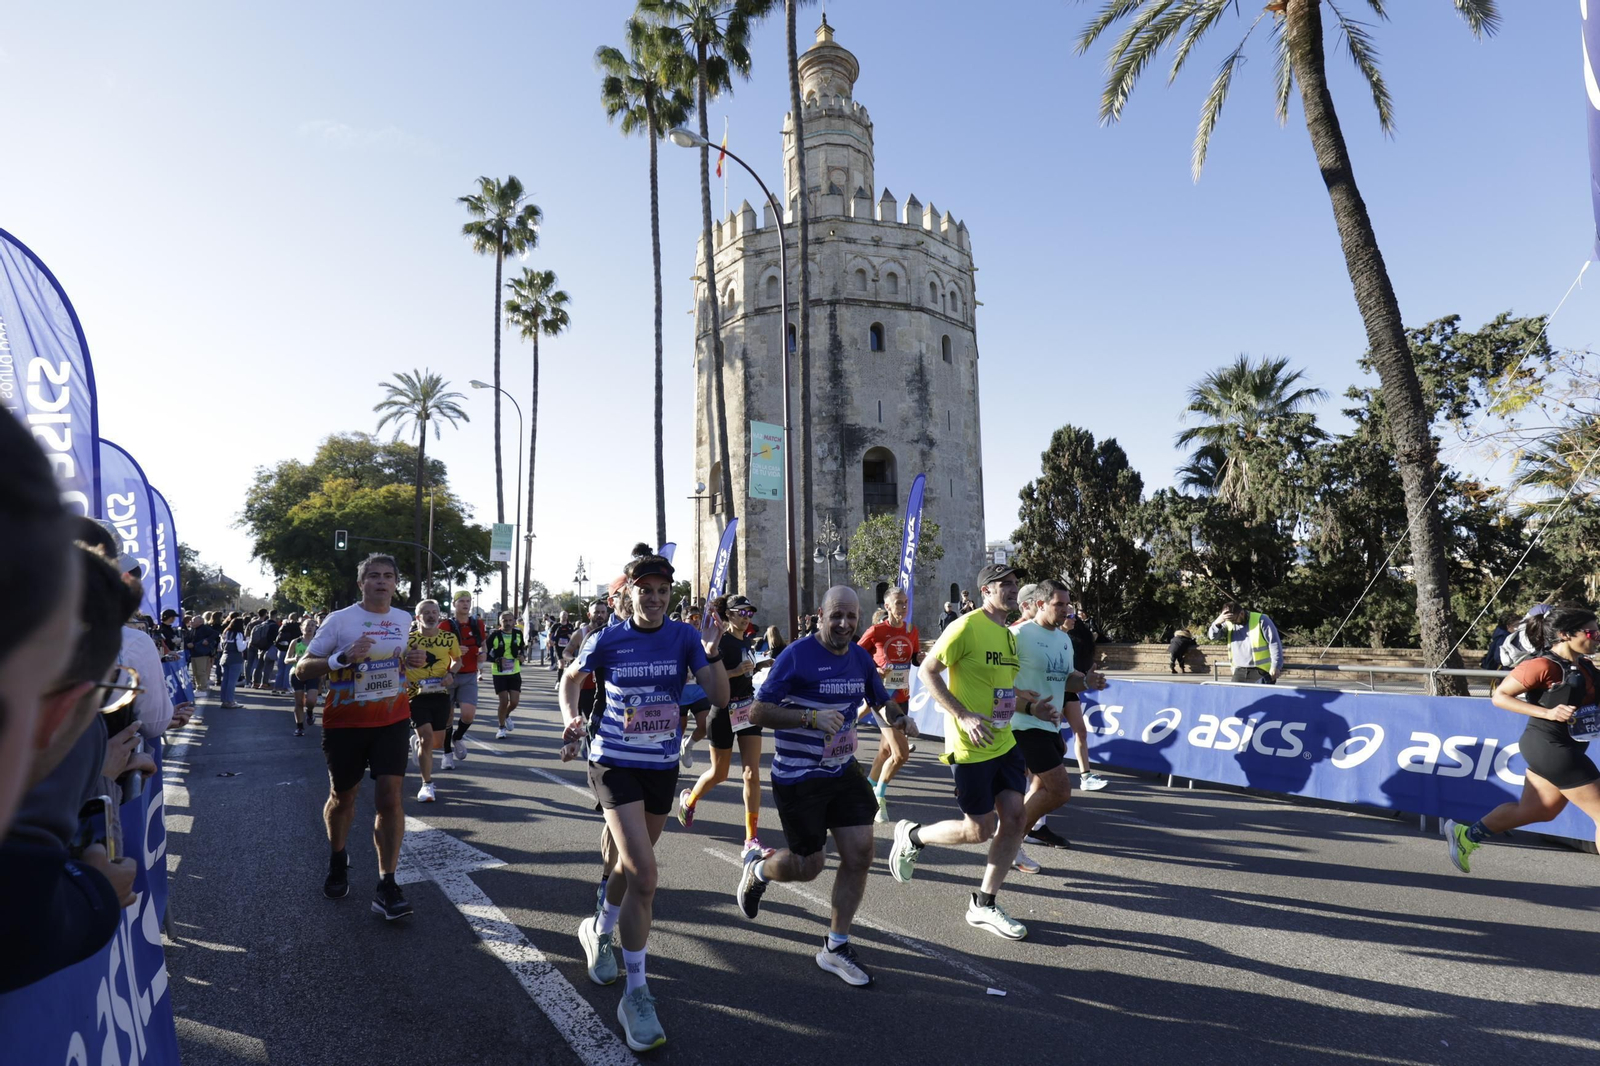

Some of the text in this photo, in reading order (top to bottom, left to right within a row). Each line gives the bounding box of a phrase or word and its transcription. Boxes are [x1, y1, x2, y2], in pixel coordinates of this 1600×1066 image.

[763, 434, 782, 443] MATCH
[370, 661, 395, 670] ZURICH
[364, 680, 393, 691] JORGE
[645, 710, 661, 718] 9638
[634, 719, 672, 732] ARAITZ
[1187, 713, 1308, 758] asics
[1396, 731, 1527, 786] asic
